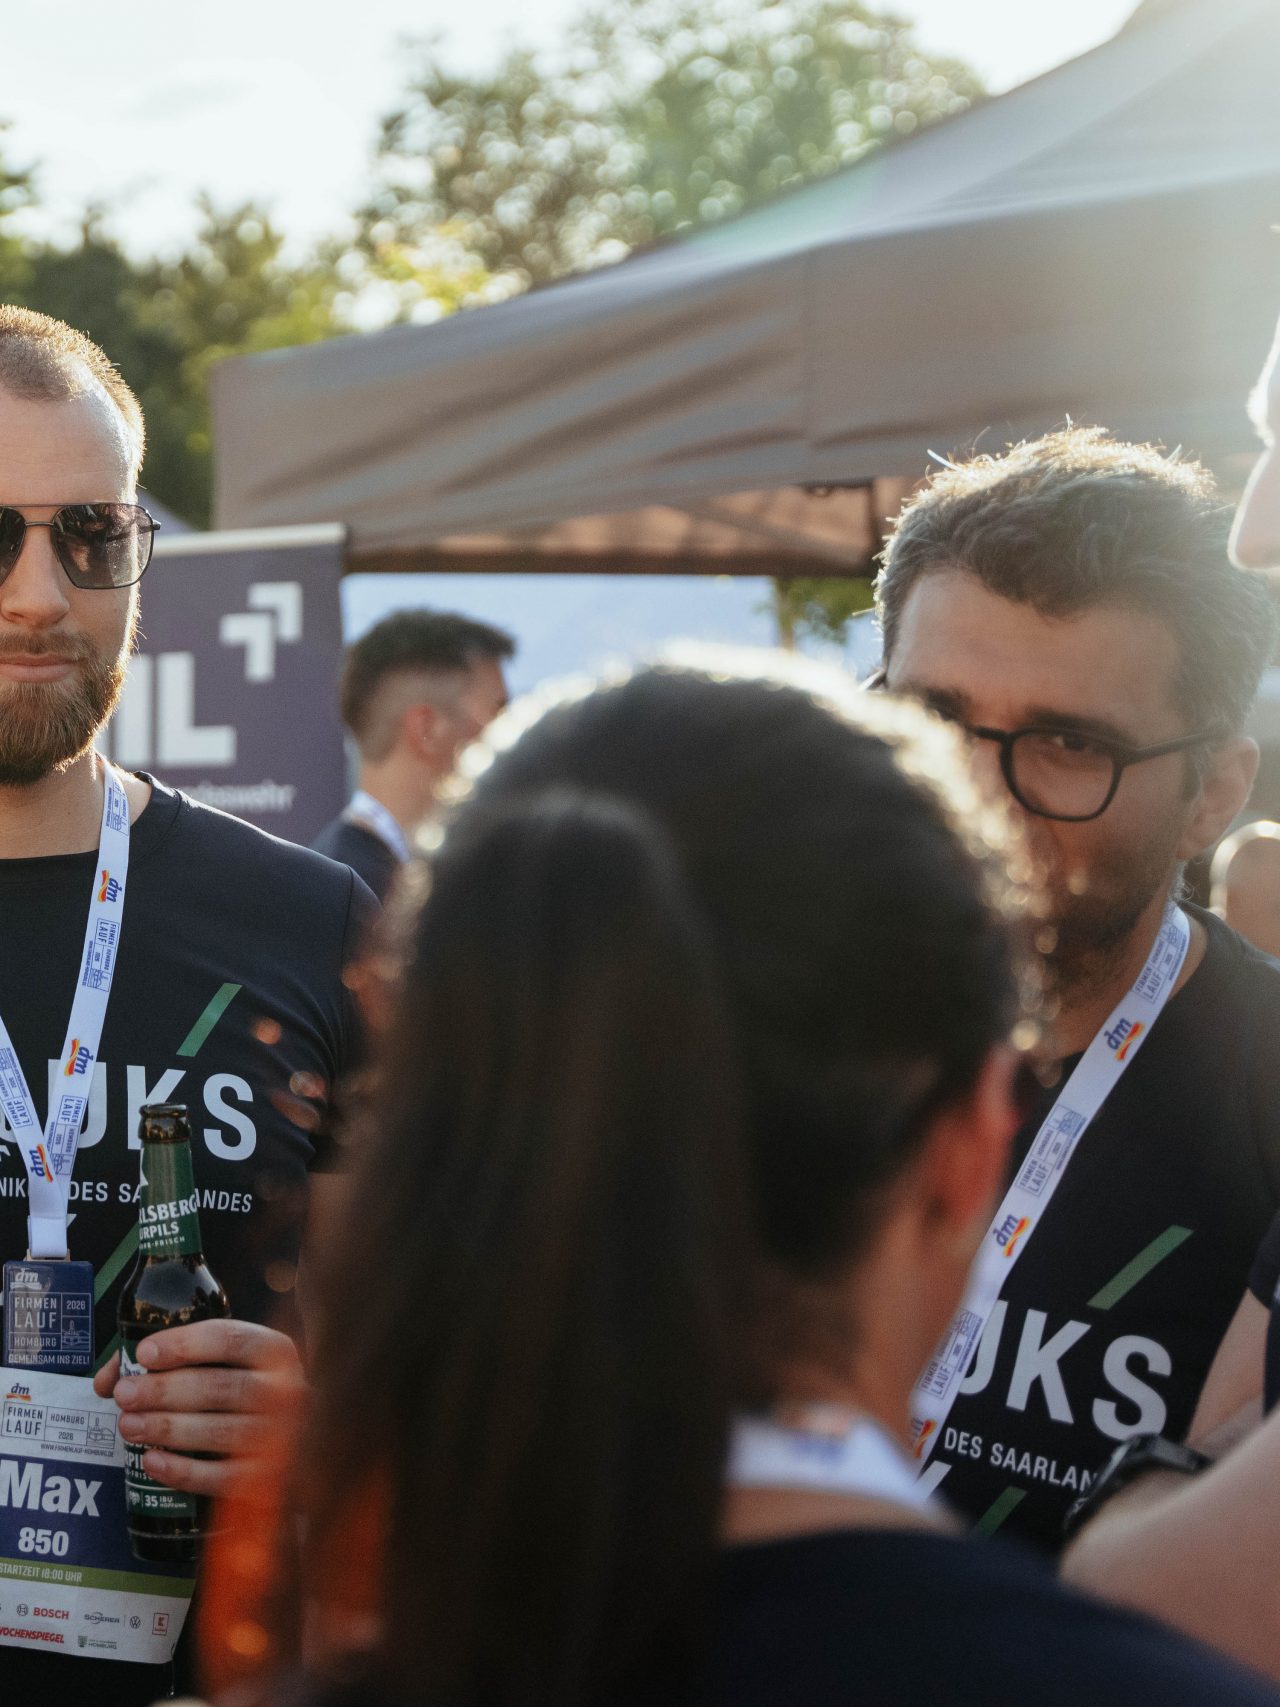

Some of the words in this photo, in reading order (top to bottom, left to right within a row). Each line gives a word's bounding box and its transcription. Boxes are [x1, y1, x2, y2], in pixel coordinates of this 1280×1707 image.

[100, 651, 237, 768] IL
[106, 877, 123, 903] dm
[98, 921, 109, 944] LAUF
[108, 923, 117, 946] FIRMEN
[1144, 972, 1162, 1000] LAUF
[1104, 1017, 1132, 1050] dm
[74, 1046, 94, 1075] dm
[6, 1102, 21, 1125] FIRMEN
[13, 1100, 30, 1124] LAUF
[61, 1098, 73, 1122] LAUF
[71, 1099, 83, 1123] FIRMEN
[29, 1150, 45, 1177] dm
[1028, 1165, 1049, 1193] LAUF
[68, 1181, 109, 1203] DES
[139, 1193, 198, 1224] LSBERG
[993, 1213, 1019, 1247] dm
[15, 1267, 39, 1282] dm
[14, 1297, 57, 1309] FIRMEN
[66, 1300, 86, 1310] 2026
[14, 1311, 57, 1329] LAUF
[14, 1337, 57, 1347] HOMBURG
[8, 1354, 55, 1365] GEMEINSAM
[57, 1355, 70, 1364] INS
[10, 1382, 30, 1395] dm
[931, 1365, 951, 1395] LAUF
[7, 1406, 43, 1420] FIRMEN
[50, 1413, 85, 1425] HOMBURG
[5, 1419, 42, 1436] LAUF
[944, 1427, 983, 1459] DES
[990, 1442, 1098, 1493] SAARLAN
[144, 1494, 158, 1508] 35
[18, 1527, 69, 1557] 850
[42, 1567, 64, 1580] 18:00
[65, 1571, 83, 1583] UHR
[33, 1606, 70, 1620] BOSCH
